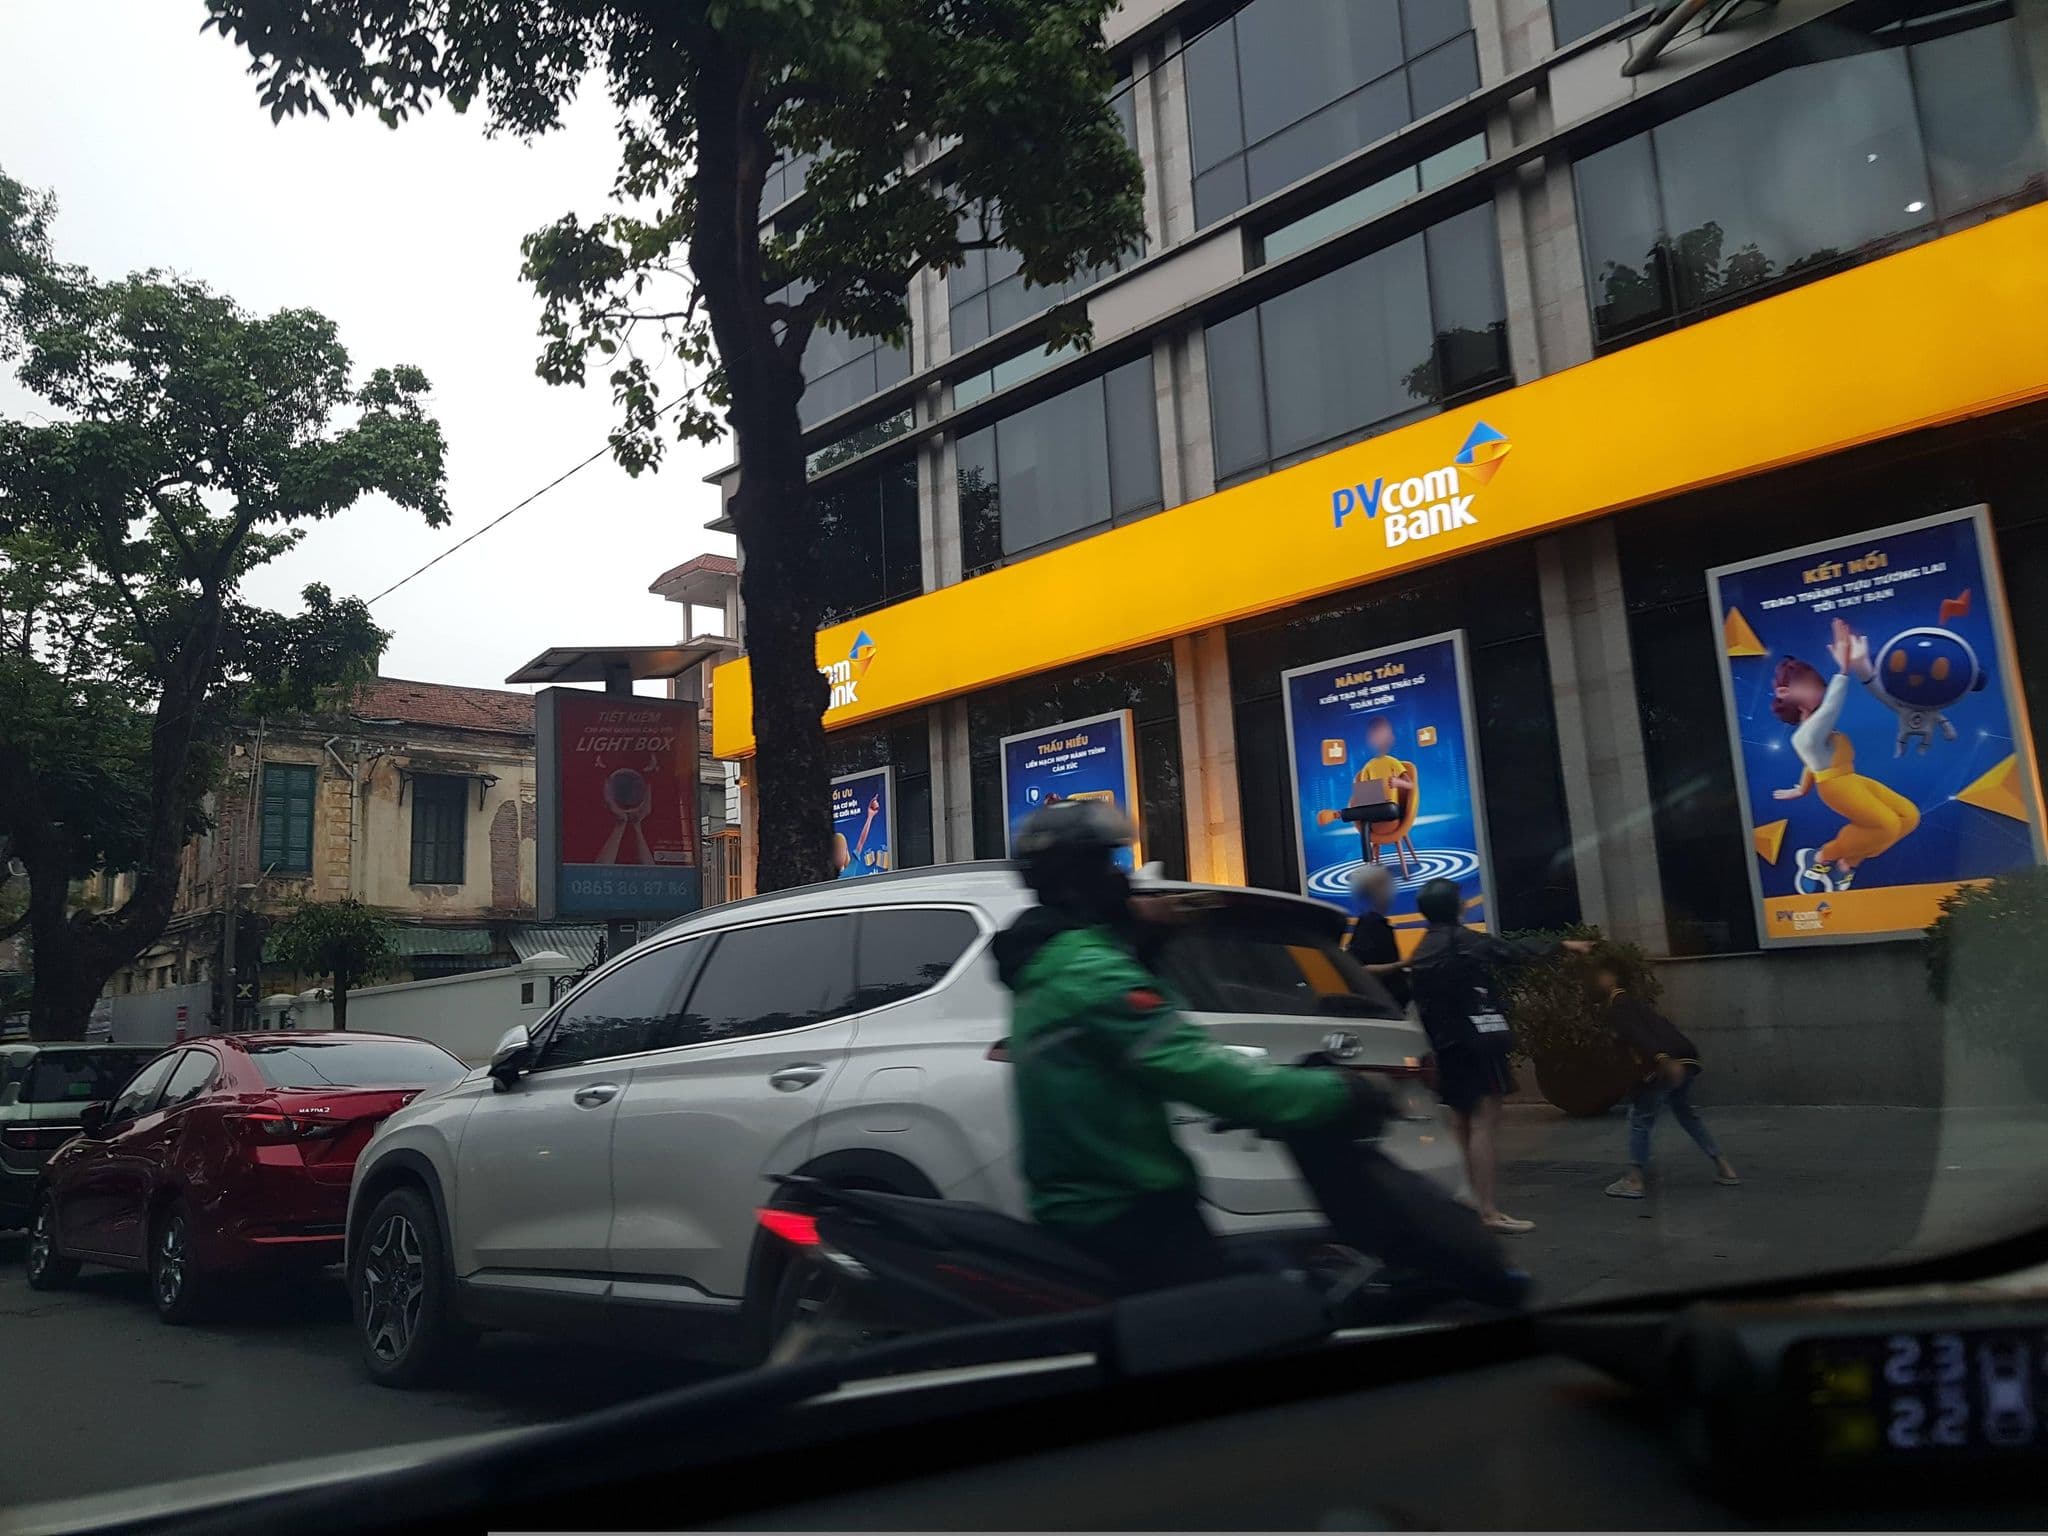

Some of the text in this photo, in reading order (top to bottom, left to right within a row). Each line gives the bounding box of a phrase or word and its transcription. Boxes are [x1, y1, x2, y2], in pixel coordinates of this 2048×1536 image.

[1332, 466, 1459, 528] PVcom
[1384, 494, 1478, 548] Bank
[1802, 561, 1844, 584] KẾT
[1760, 595, 1797, 609] TRAO
[1921, 562, 1947, 575] LAI
[1335, 671, 1373, 688] NÂNG
[576, 736, 676, 752] LIGHT BOX
[1038, 739, 1063, 755] THẤU
